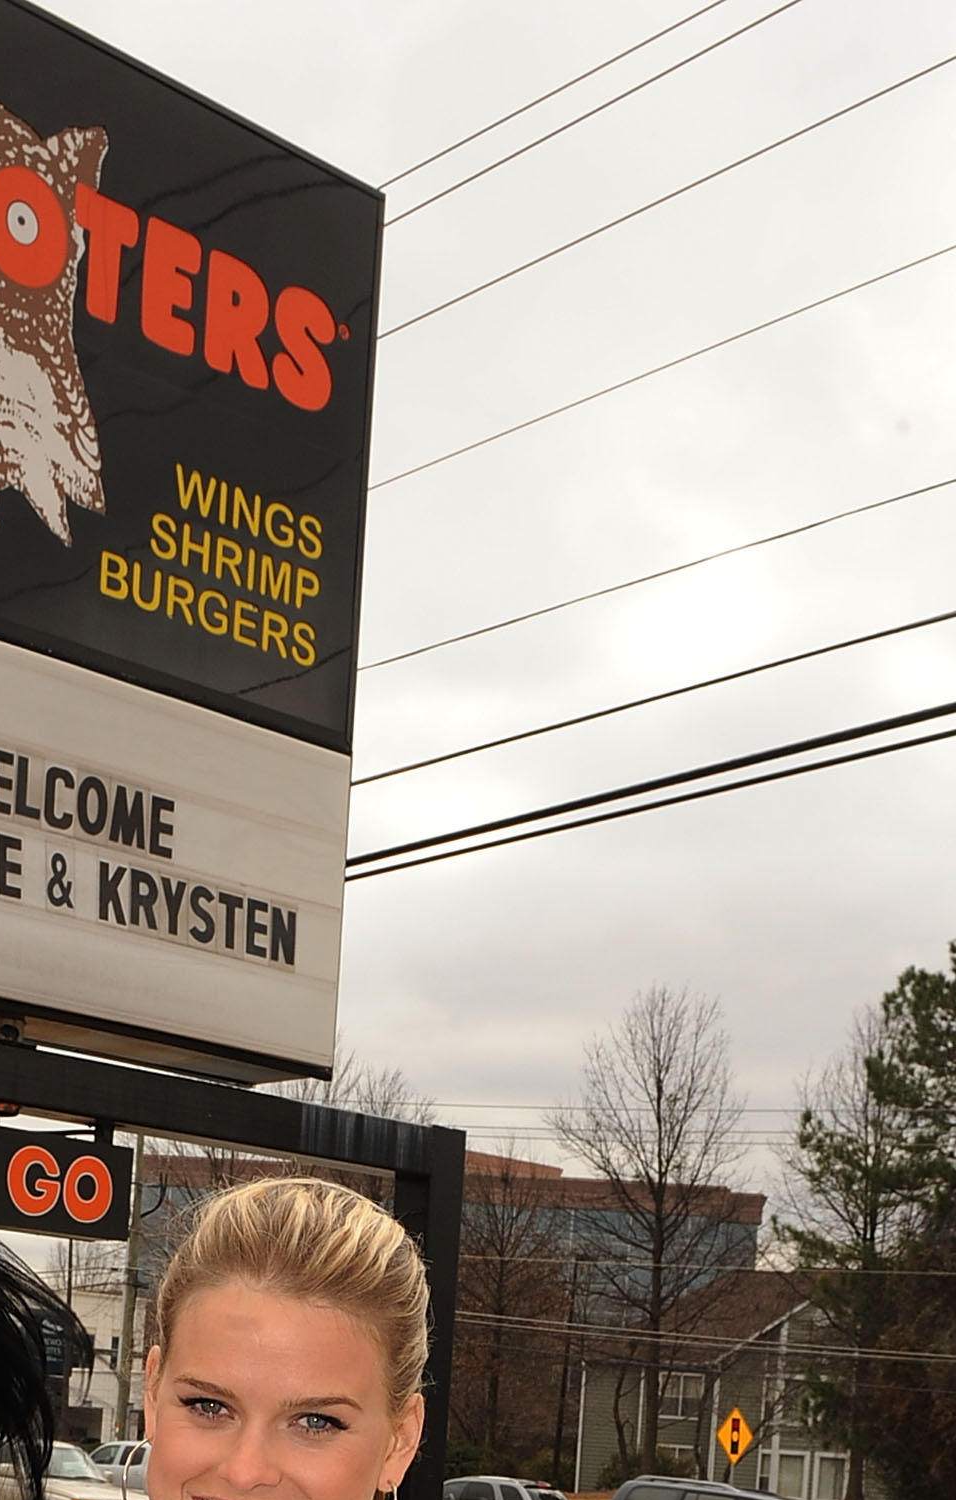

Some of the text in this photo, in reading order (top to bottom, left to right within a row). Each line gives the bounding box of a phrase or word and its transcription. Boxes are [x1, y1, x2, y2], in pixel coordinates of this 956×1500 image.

[174, 463, 323, 559] WINGS
[99, 551, 317, 667] BURGERS
[149, 514, 321, 609] SHRIMP
[47, 852, 75, 909] &
[98, 860, 297, 966] KRYSTEN
[6, 1145, 114, 1224] GO
